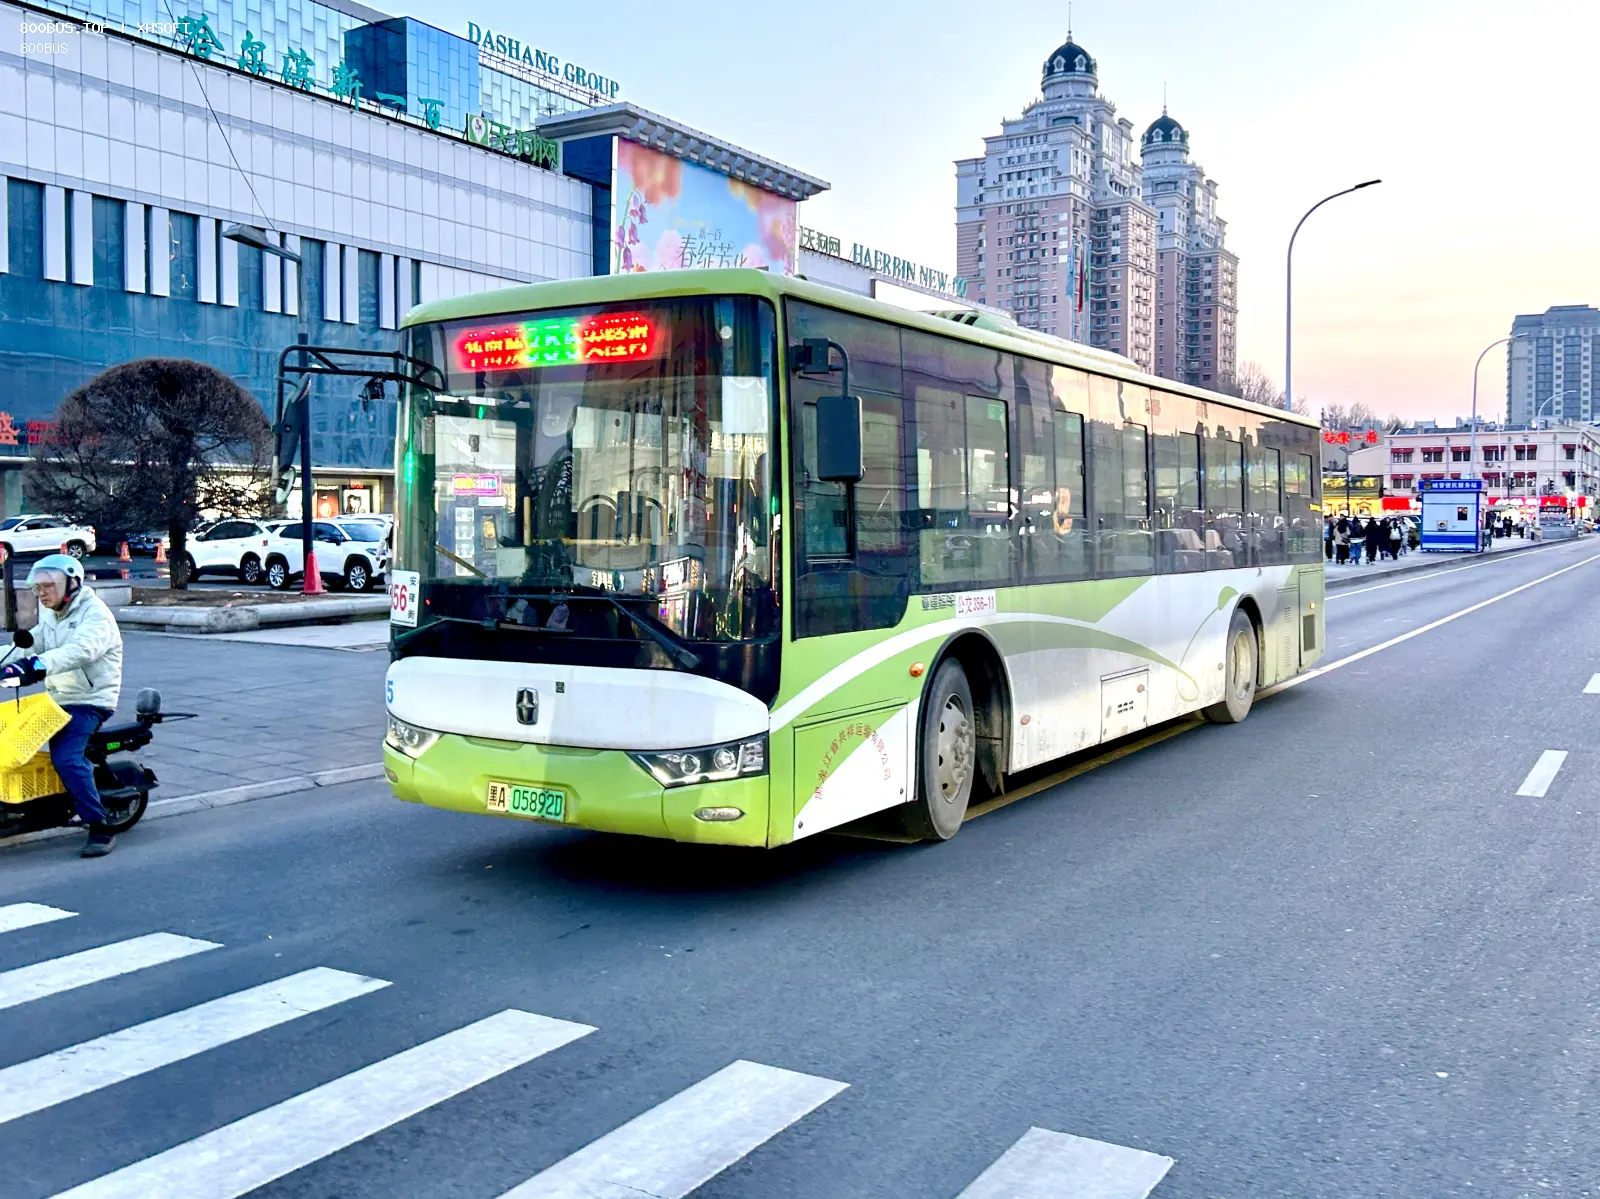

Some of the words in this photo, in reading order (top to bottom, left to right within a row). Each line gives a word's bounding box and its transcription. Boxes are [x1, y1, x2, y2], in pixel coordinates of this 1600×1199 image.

[467, 21, 560, 76] DASHANG
[564, 62, 620, 99] GROUP
[803, 226, 841, 258] 天狗网
[852, 242, 916, 282] HAERBIN
[920, 264, 948, 292] NEW
